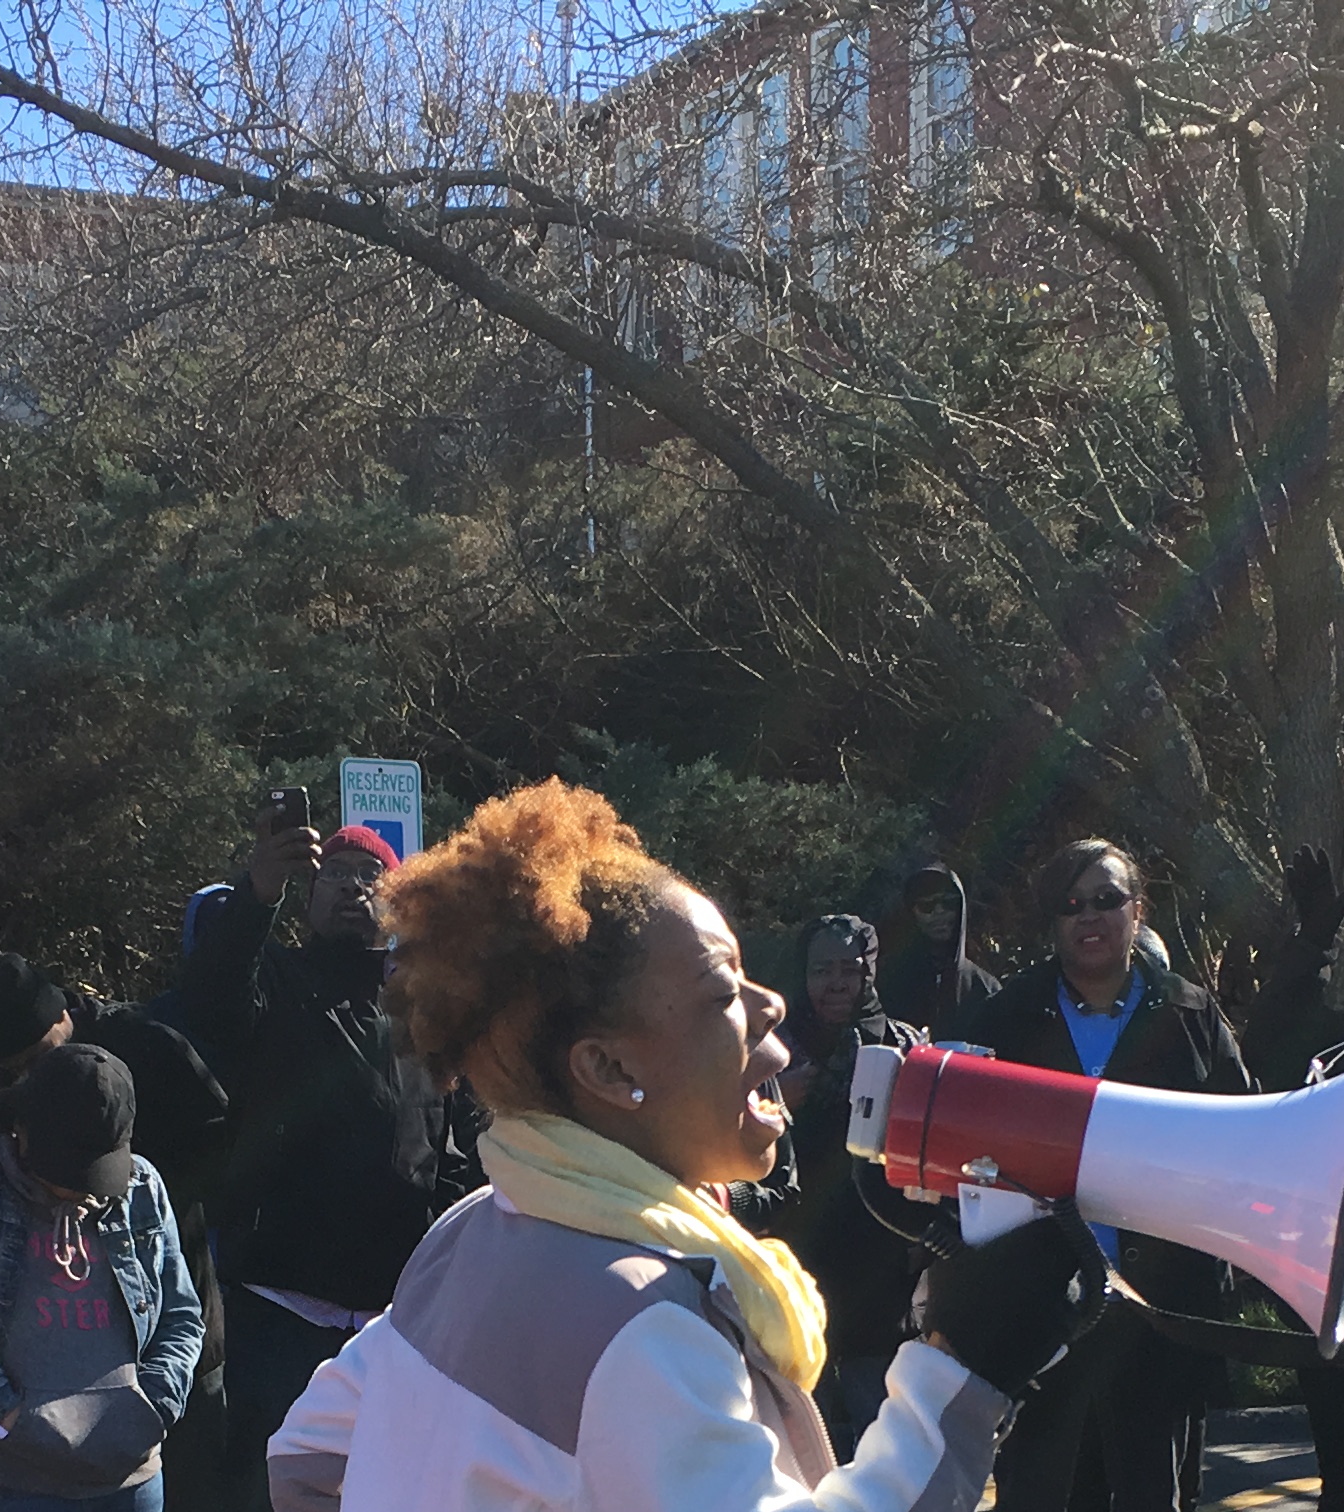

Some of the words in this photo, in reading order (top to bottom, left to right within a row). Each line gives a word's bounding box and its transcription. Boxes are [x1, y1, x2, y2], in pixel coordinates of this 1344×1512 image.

[347, 771, 415, 793] RESERVED
[352, 793, 411, 815] PARKING
[35, 1296, 111, 1331] STER
